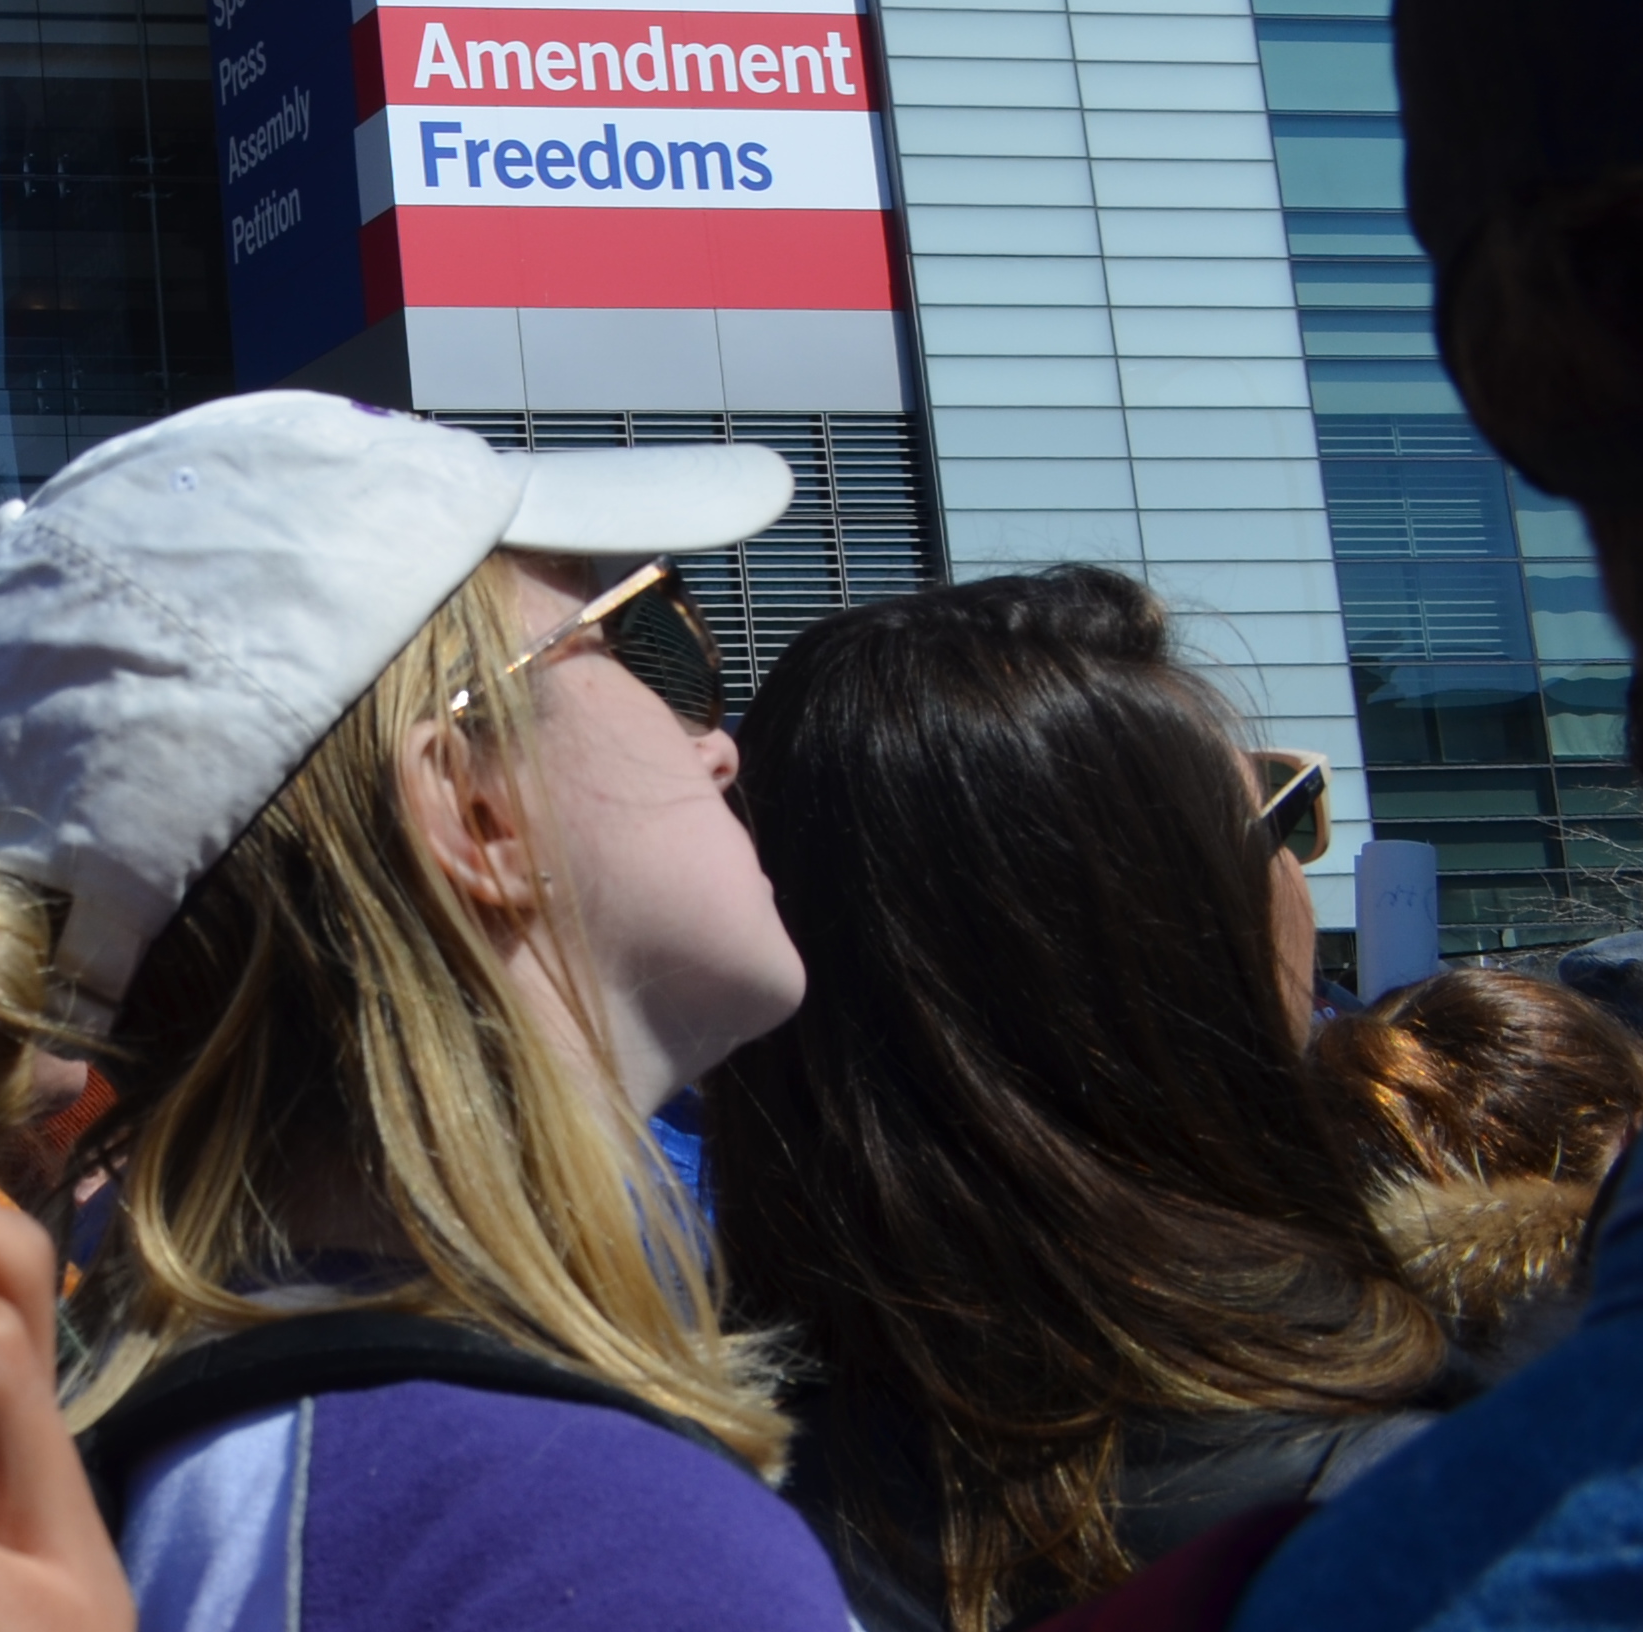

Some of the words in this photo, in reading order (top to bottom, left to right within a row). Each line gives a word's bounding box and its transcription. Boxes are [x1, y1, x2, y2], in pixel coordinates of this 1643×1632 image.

[218, 40, 267, 106] Press
[414, 22, 856, 96] Amendment
[227, 84, 310, 185] Assembly
[419, 121, 774, 191] Freedoms
[231, 187, 302, 265] Petition
